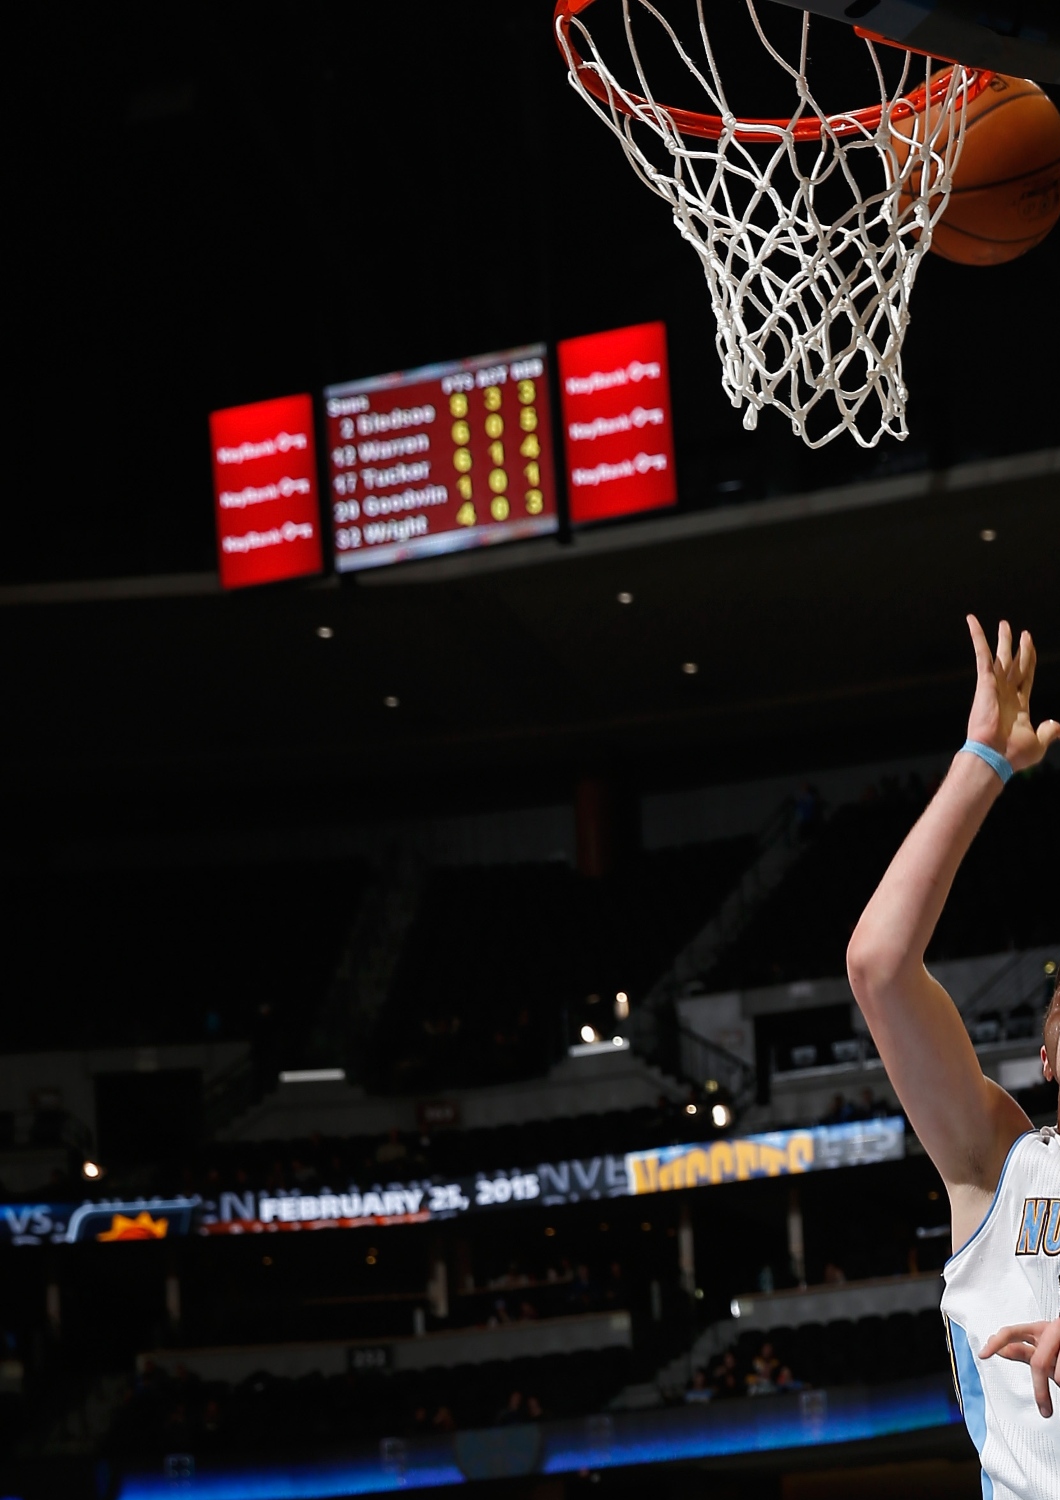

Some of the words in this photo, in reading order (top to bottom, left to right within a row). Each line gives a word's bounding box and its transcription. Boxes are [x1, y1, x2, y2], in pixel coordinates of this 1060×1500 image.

[259, 1189, 424, 1223] FEBRUARY
[429, 1184, 470, 1211] 25,
[475, 1174, 540, 1206] 2015
